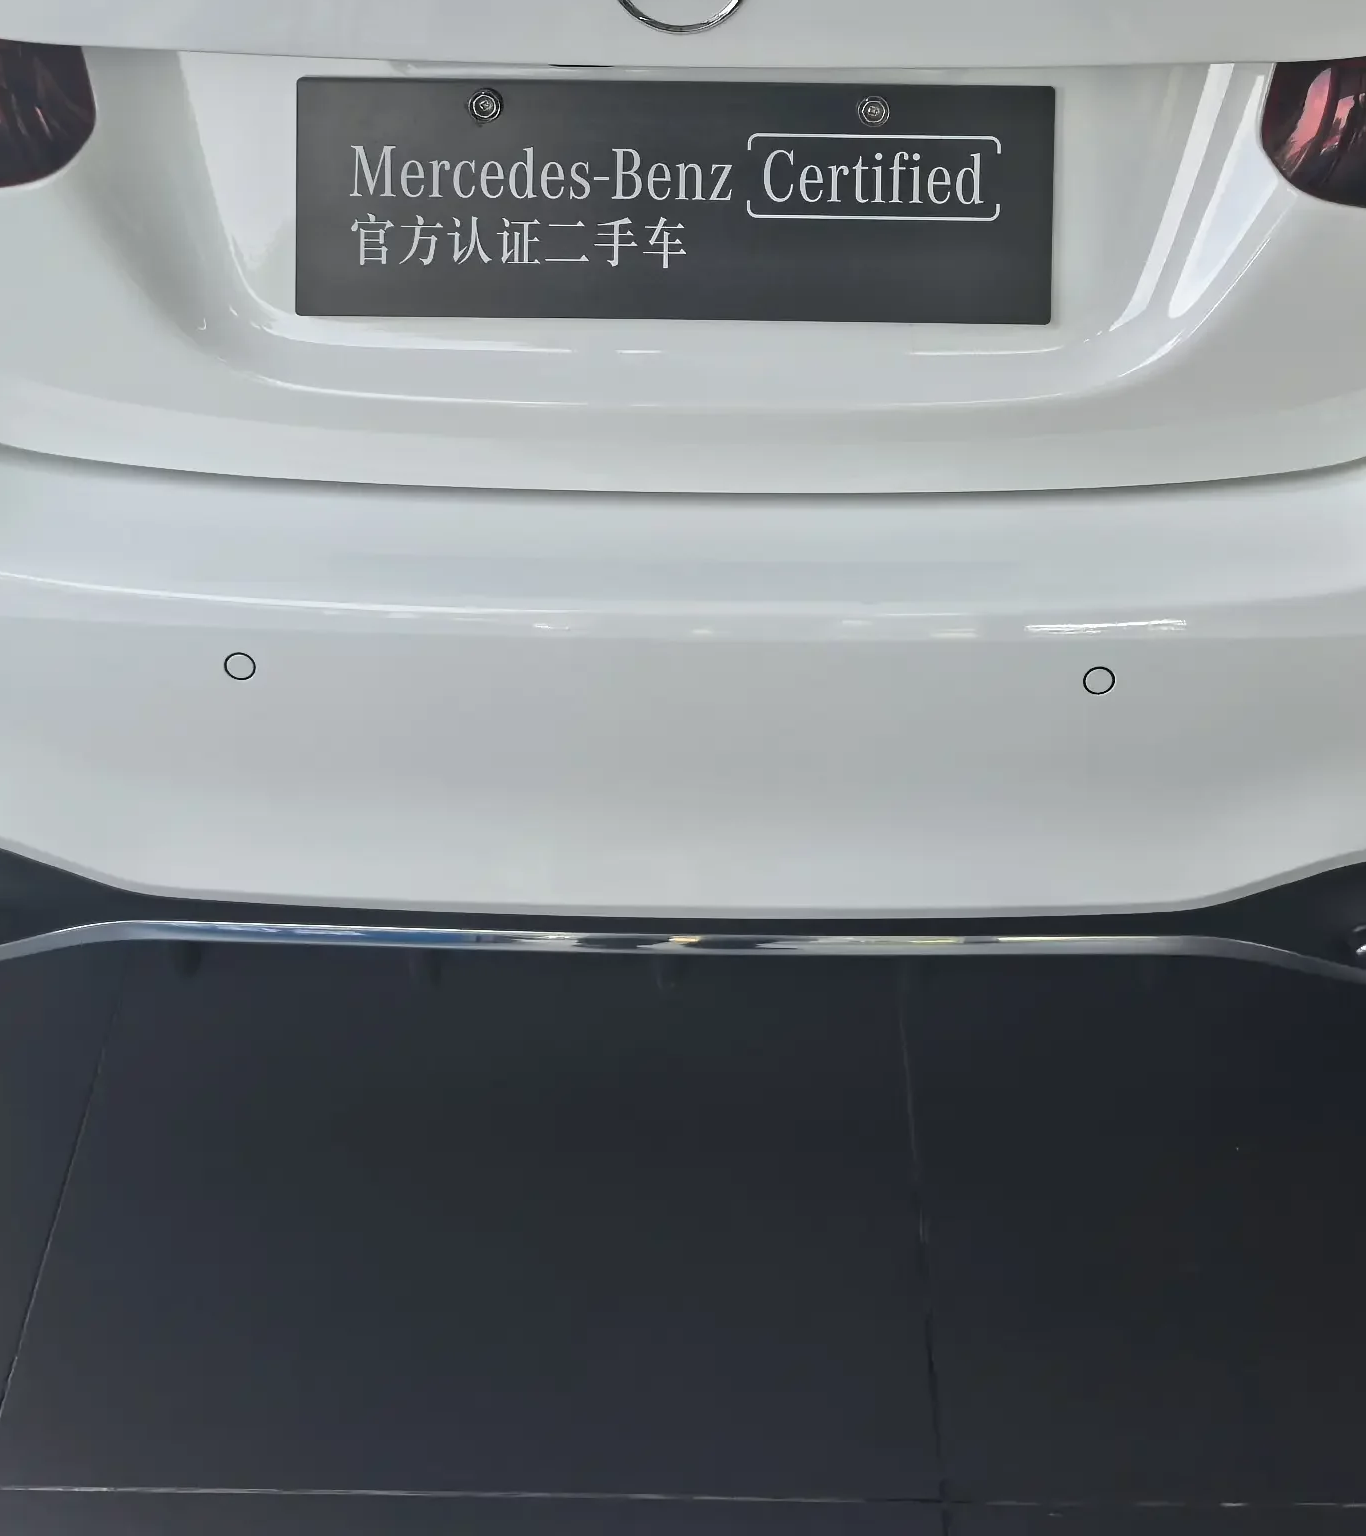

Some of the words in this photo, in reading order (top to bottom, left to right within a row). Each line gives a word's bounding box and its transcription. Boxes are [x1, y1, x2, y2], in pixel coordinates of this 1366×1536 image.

[349, 144, 733, 201] Mercedes-Benz
[763, 149, 985, 205] Certified
[349, 212, 687, 269] 官方认证二手车
